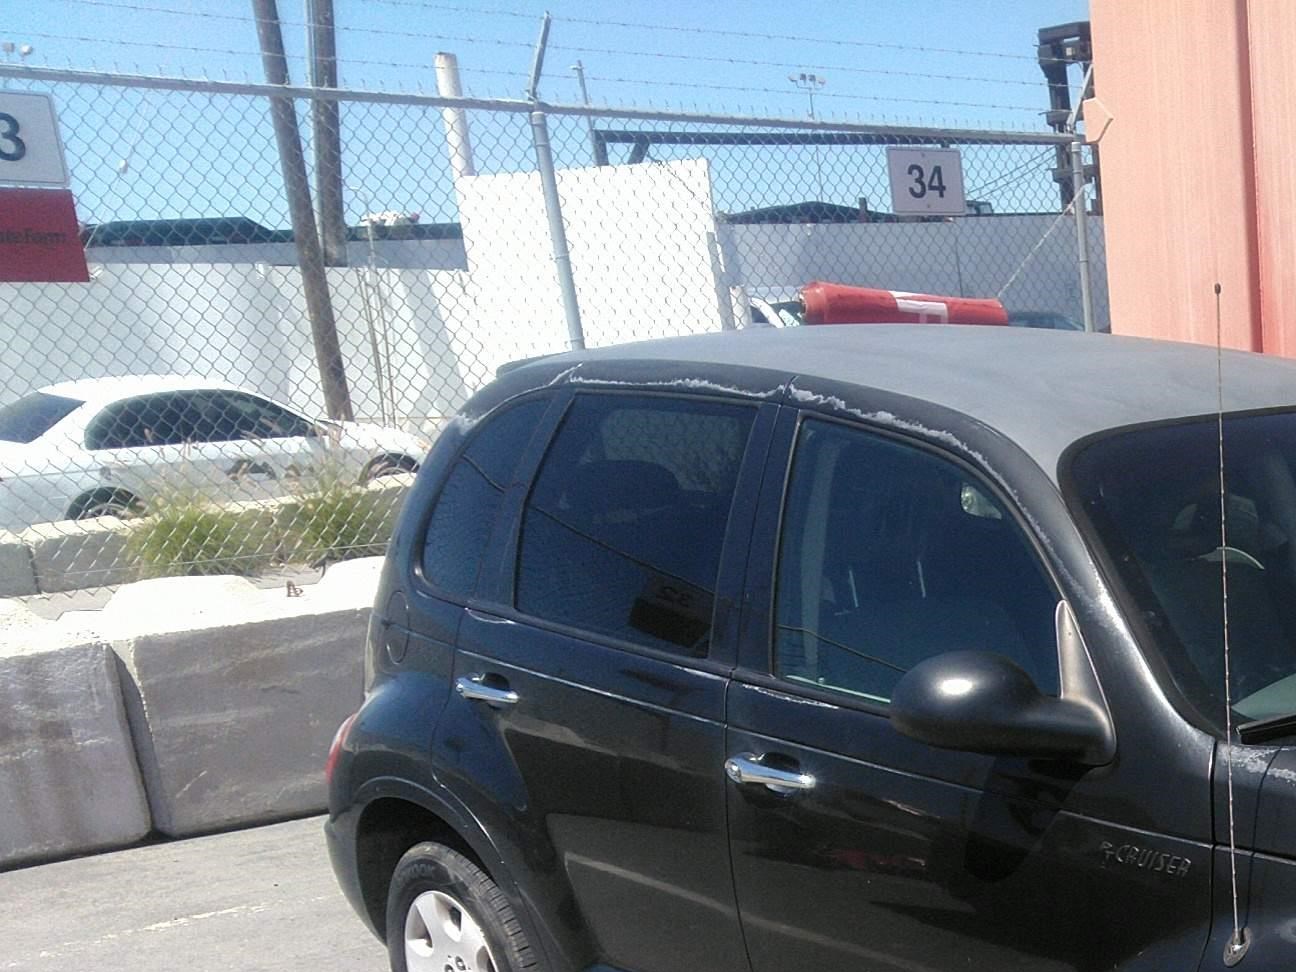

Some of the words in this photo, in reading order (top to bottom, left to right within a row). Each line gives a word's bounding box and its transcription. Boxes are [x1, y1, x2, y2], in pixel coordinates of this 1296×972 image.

[0, 112, 26, 162] 3
[908, 164, 946, 199] 34
[1115, 844, 1192, 877] CRUISER
